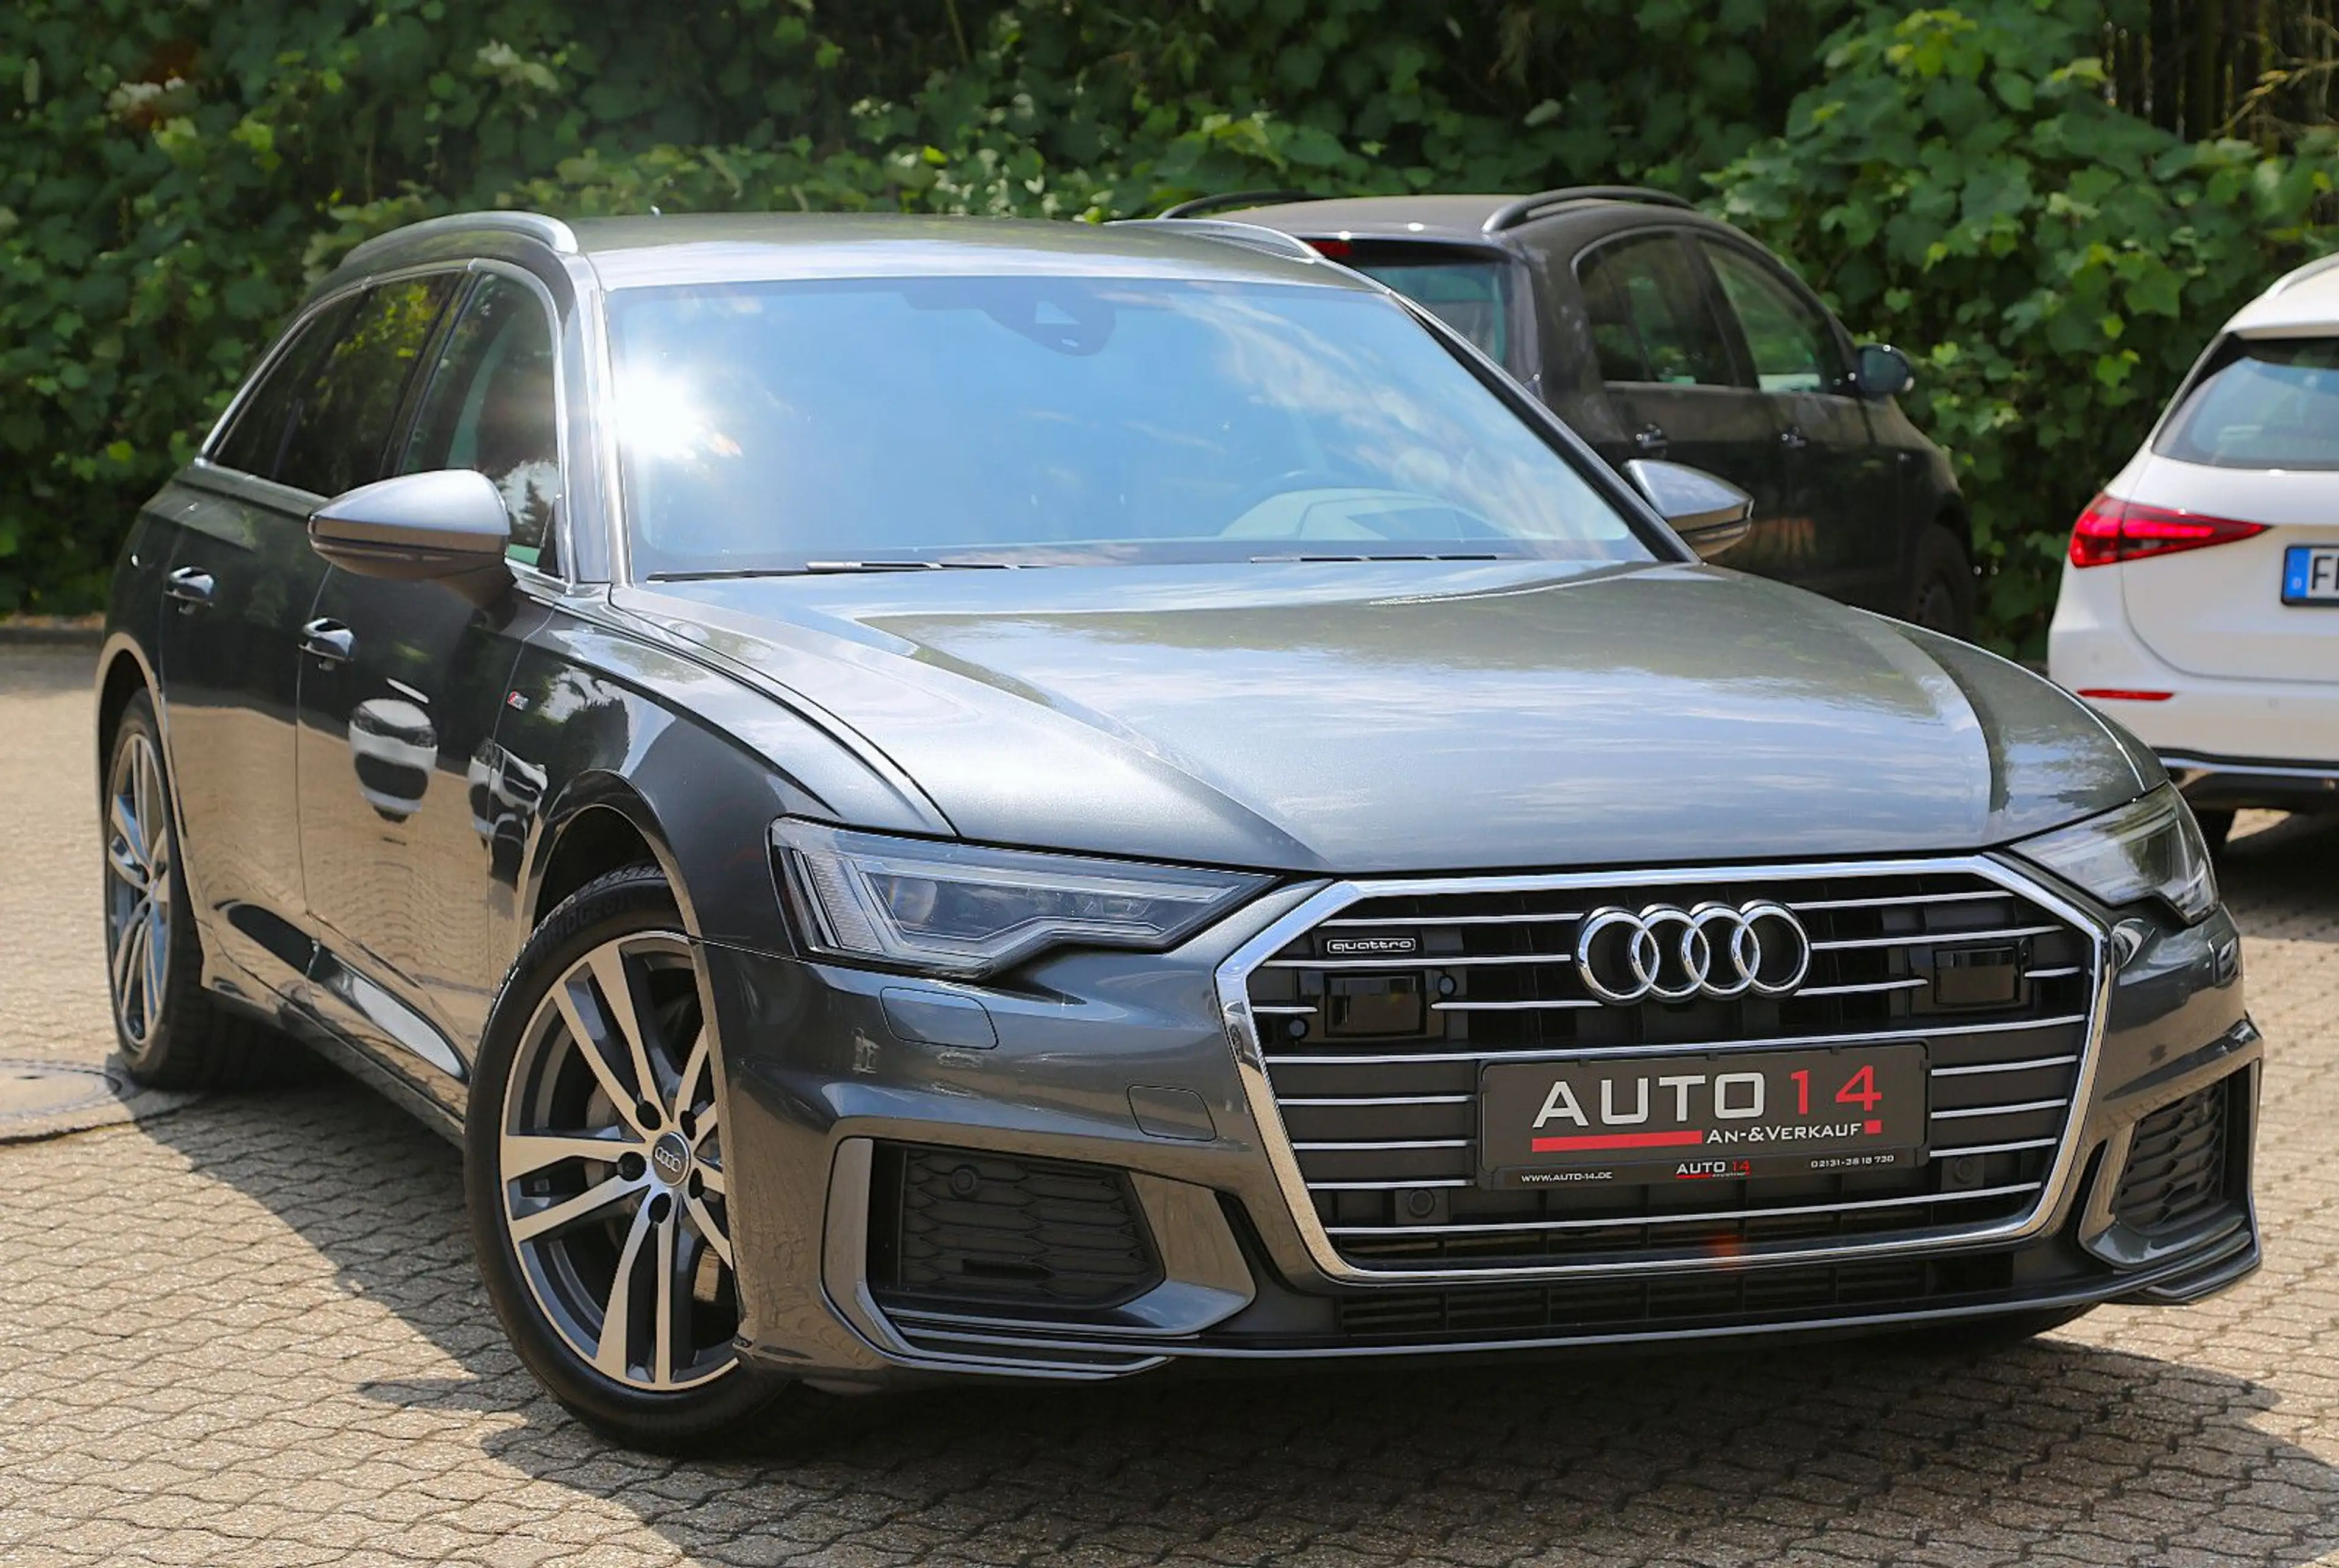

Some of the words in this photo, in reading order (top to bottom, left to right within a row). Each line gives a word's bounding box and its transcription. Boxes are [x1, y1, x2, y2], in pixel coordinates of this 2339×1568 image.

[2311, 556, 2339, 591] F
[1332, 940, 1412, 953] quattro
[1532, 1072, 1765, 1128] AUTO
[1790, 1064, 1883, 1116] 14
[1676, 1161, 1726, 1174] AUTO
[1732, 1159, 1751, 1172] 14
